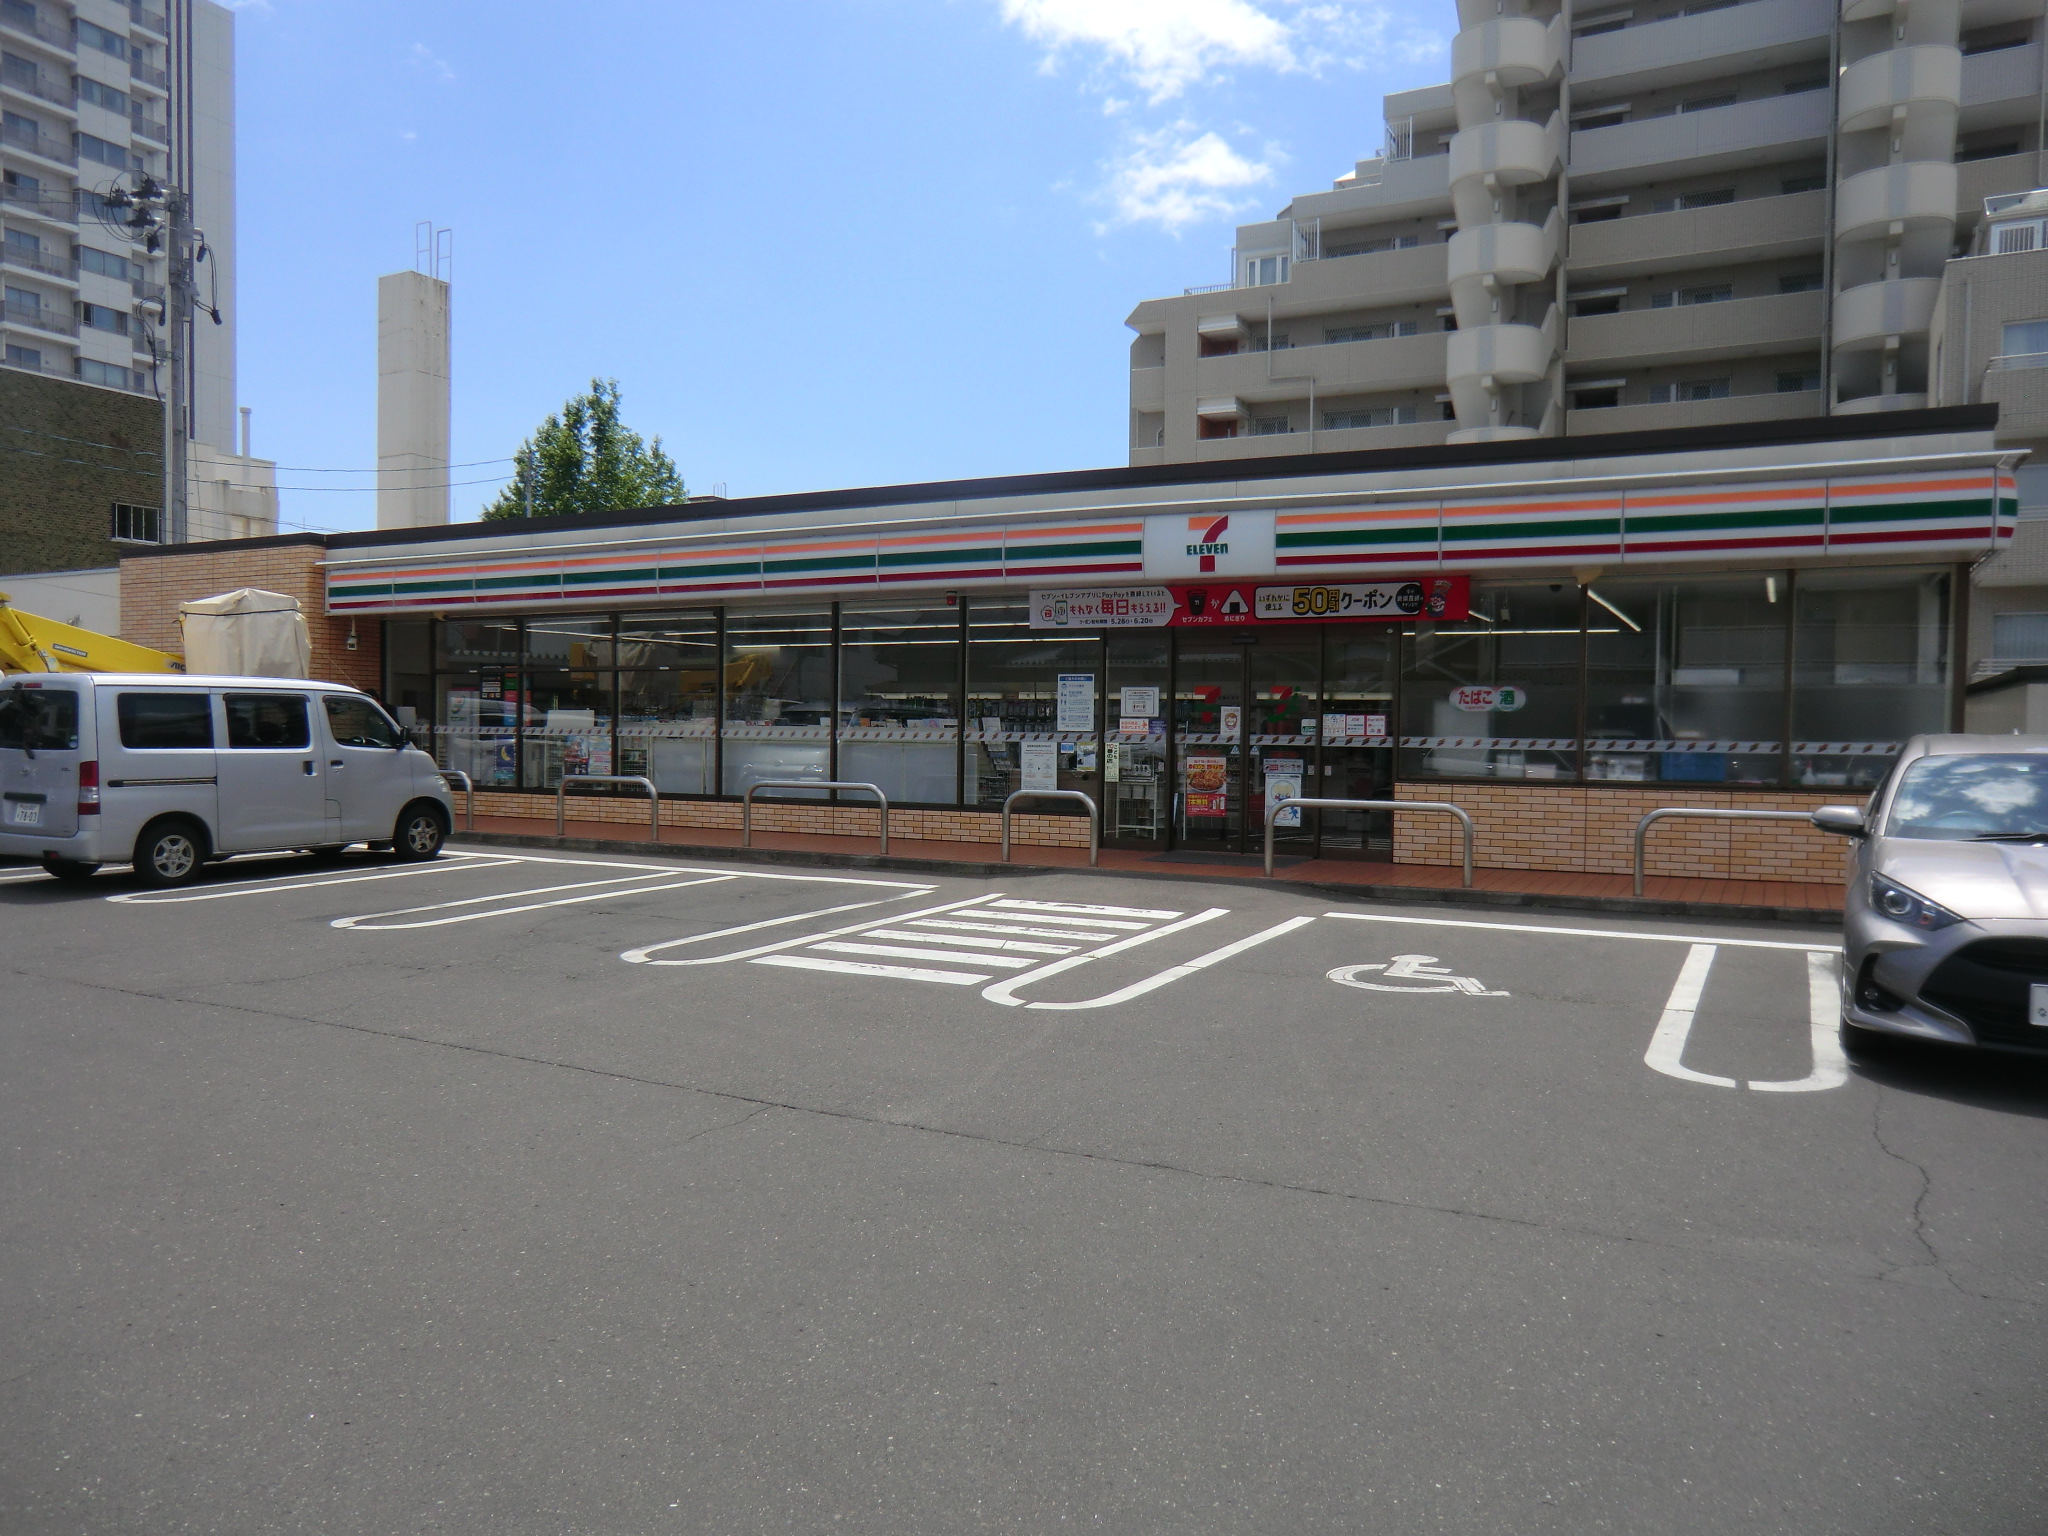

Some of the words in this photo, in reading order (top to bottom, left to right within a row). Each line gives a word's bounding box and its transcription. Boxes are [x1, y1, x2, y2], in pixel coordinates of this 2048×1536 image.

[1210, 598, 1220, 610] か
[1292, 586, 1330, 616] 50
[1341, 588, 1393, 610] クーポン
[1264, 603, 1283, 612] 使える
[1223, 615, 1246, 623] おにぎり
[170, 661, 186, 672] AIC
[1458, 689, 1493, 705] たばこ
[1499, 689, 1516, 705] 酒
